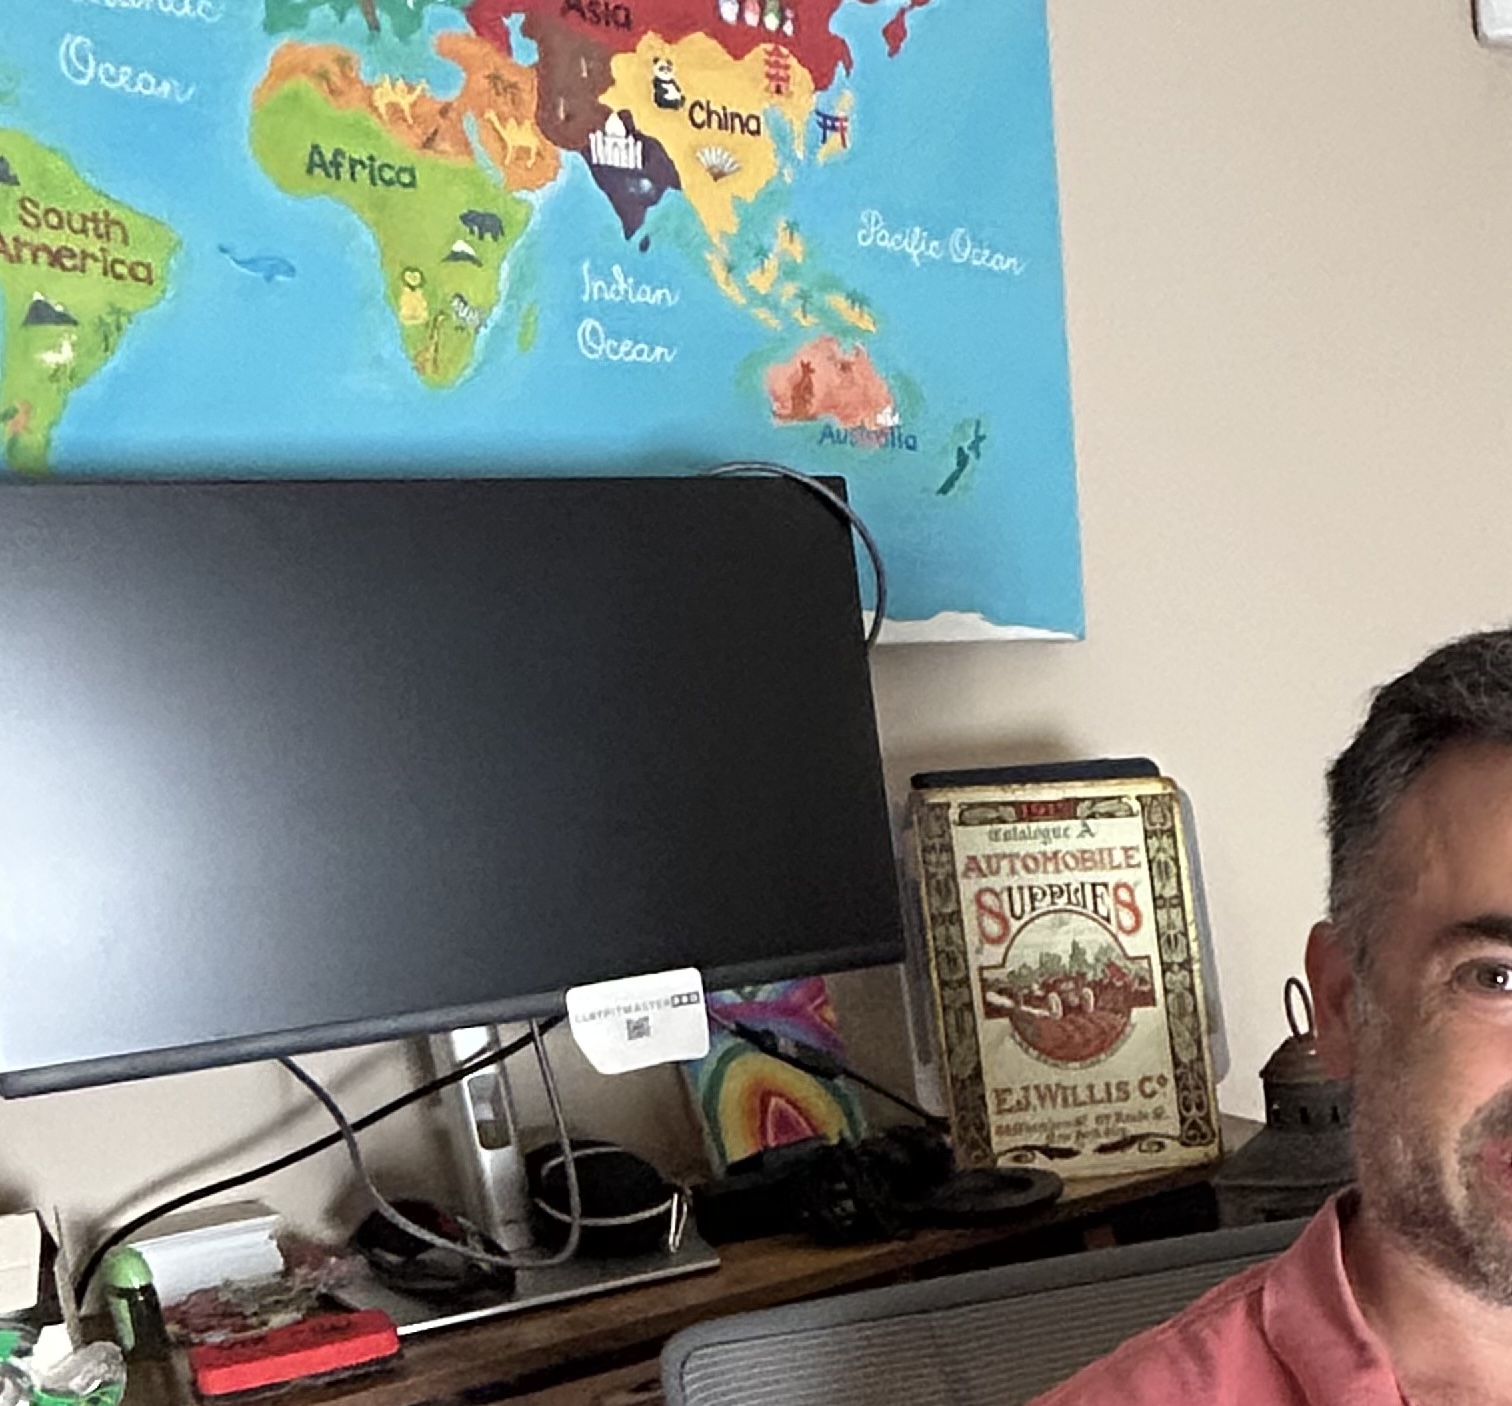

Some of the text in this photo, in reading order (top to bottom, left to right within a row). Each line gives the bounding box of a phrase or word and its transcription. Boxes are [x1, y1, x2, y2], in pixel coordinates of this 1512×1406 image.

[59, 33, 196, 103] Ocean
[688, 100, 762, 137] China
[306, 144, 417, 190] Africa
[18, 196, 129, 246] South
[857, 208, 1030, 275] Pacific Ocean
[582, 260, 680, 306] Indian
[577, 318, 678, 364] Ocean
[1076, 820, 1096, 839] A
[961, 845, 1142, 879] AUTOMOBILE
[974, 881, 1143, 945] SUPPLIES
